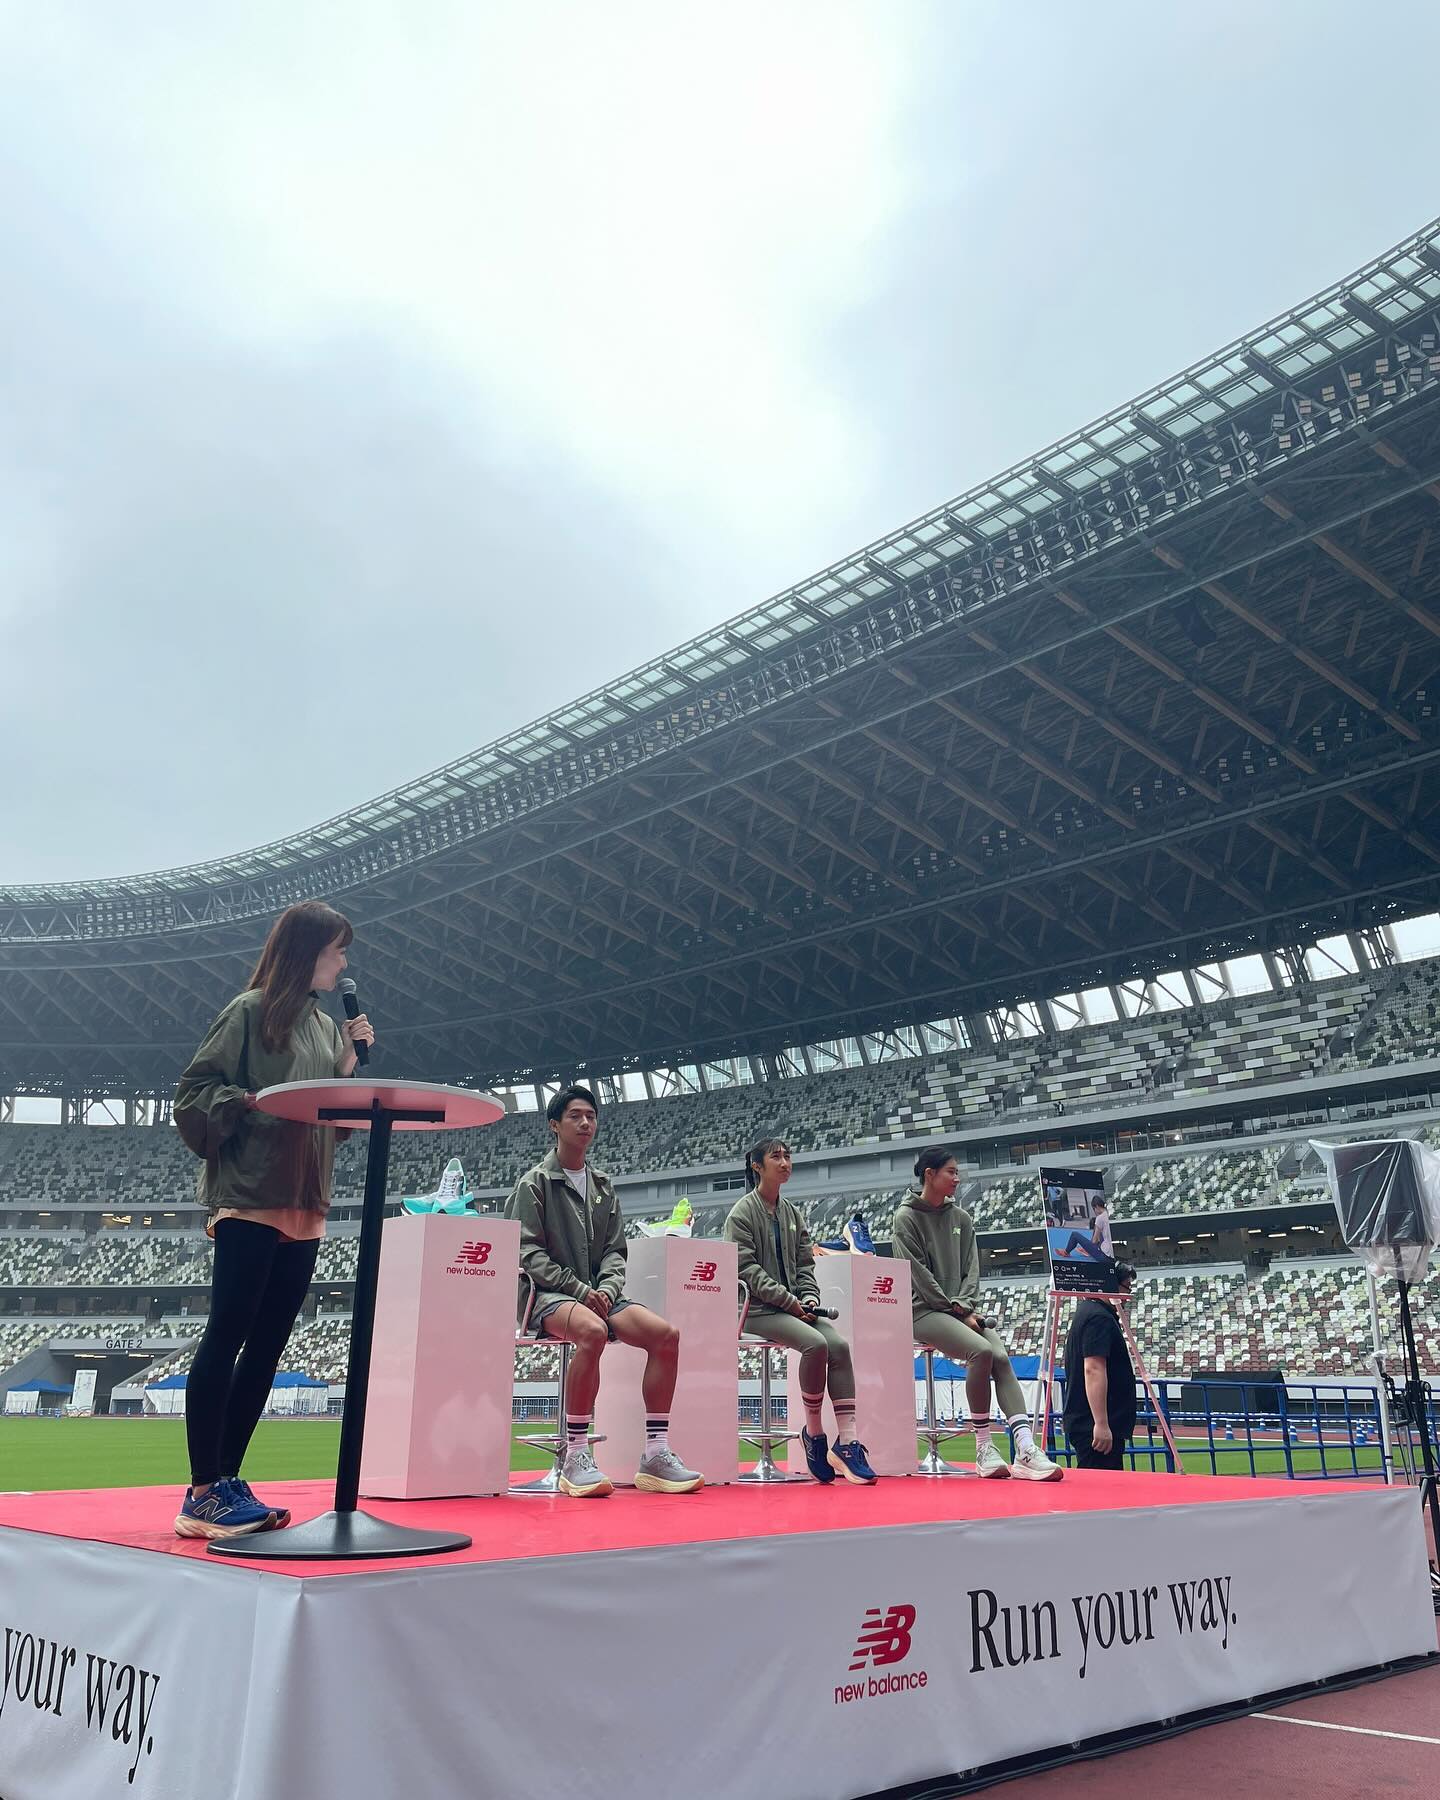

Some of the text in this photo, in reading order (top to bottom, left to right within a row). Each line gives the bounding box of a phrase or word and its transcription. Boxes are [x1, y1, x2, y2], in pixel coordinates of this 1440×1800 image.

[446, 1266, 496, 1277] new balance
[683, 1283, 722, 1293] new balance
[877, 1296, 898, 1305] balance
[105, 1339, 143, 1349] GATE 2
[848, 1604, 916, 1671] NB
[967, 1577, 1237, 1679] Run your way.
[834, 1670, 928, 1704] new balance
[0, 1628, 161, 1785] your way.
